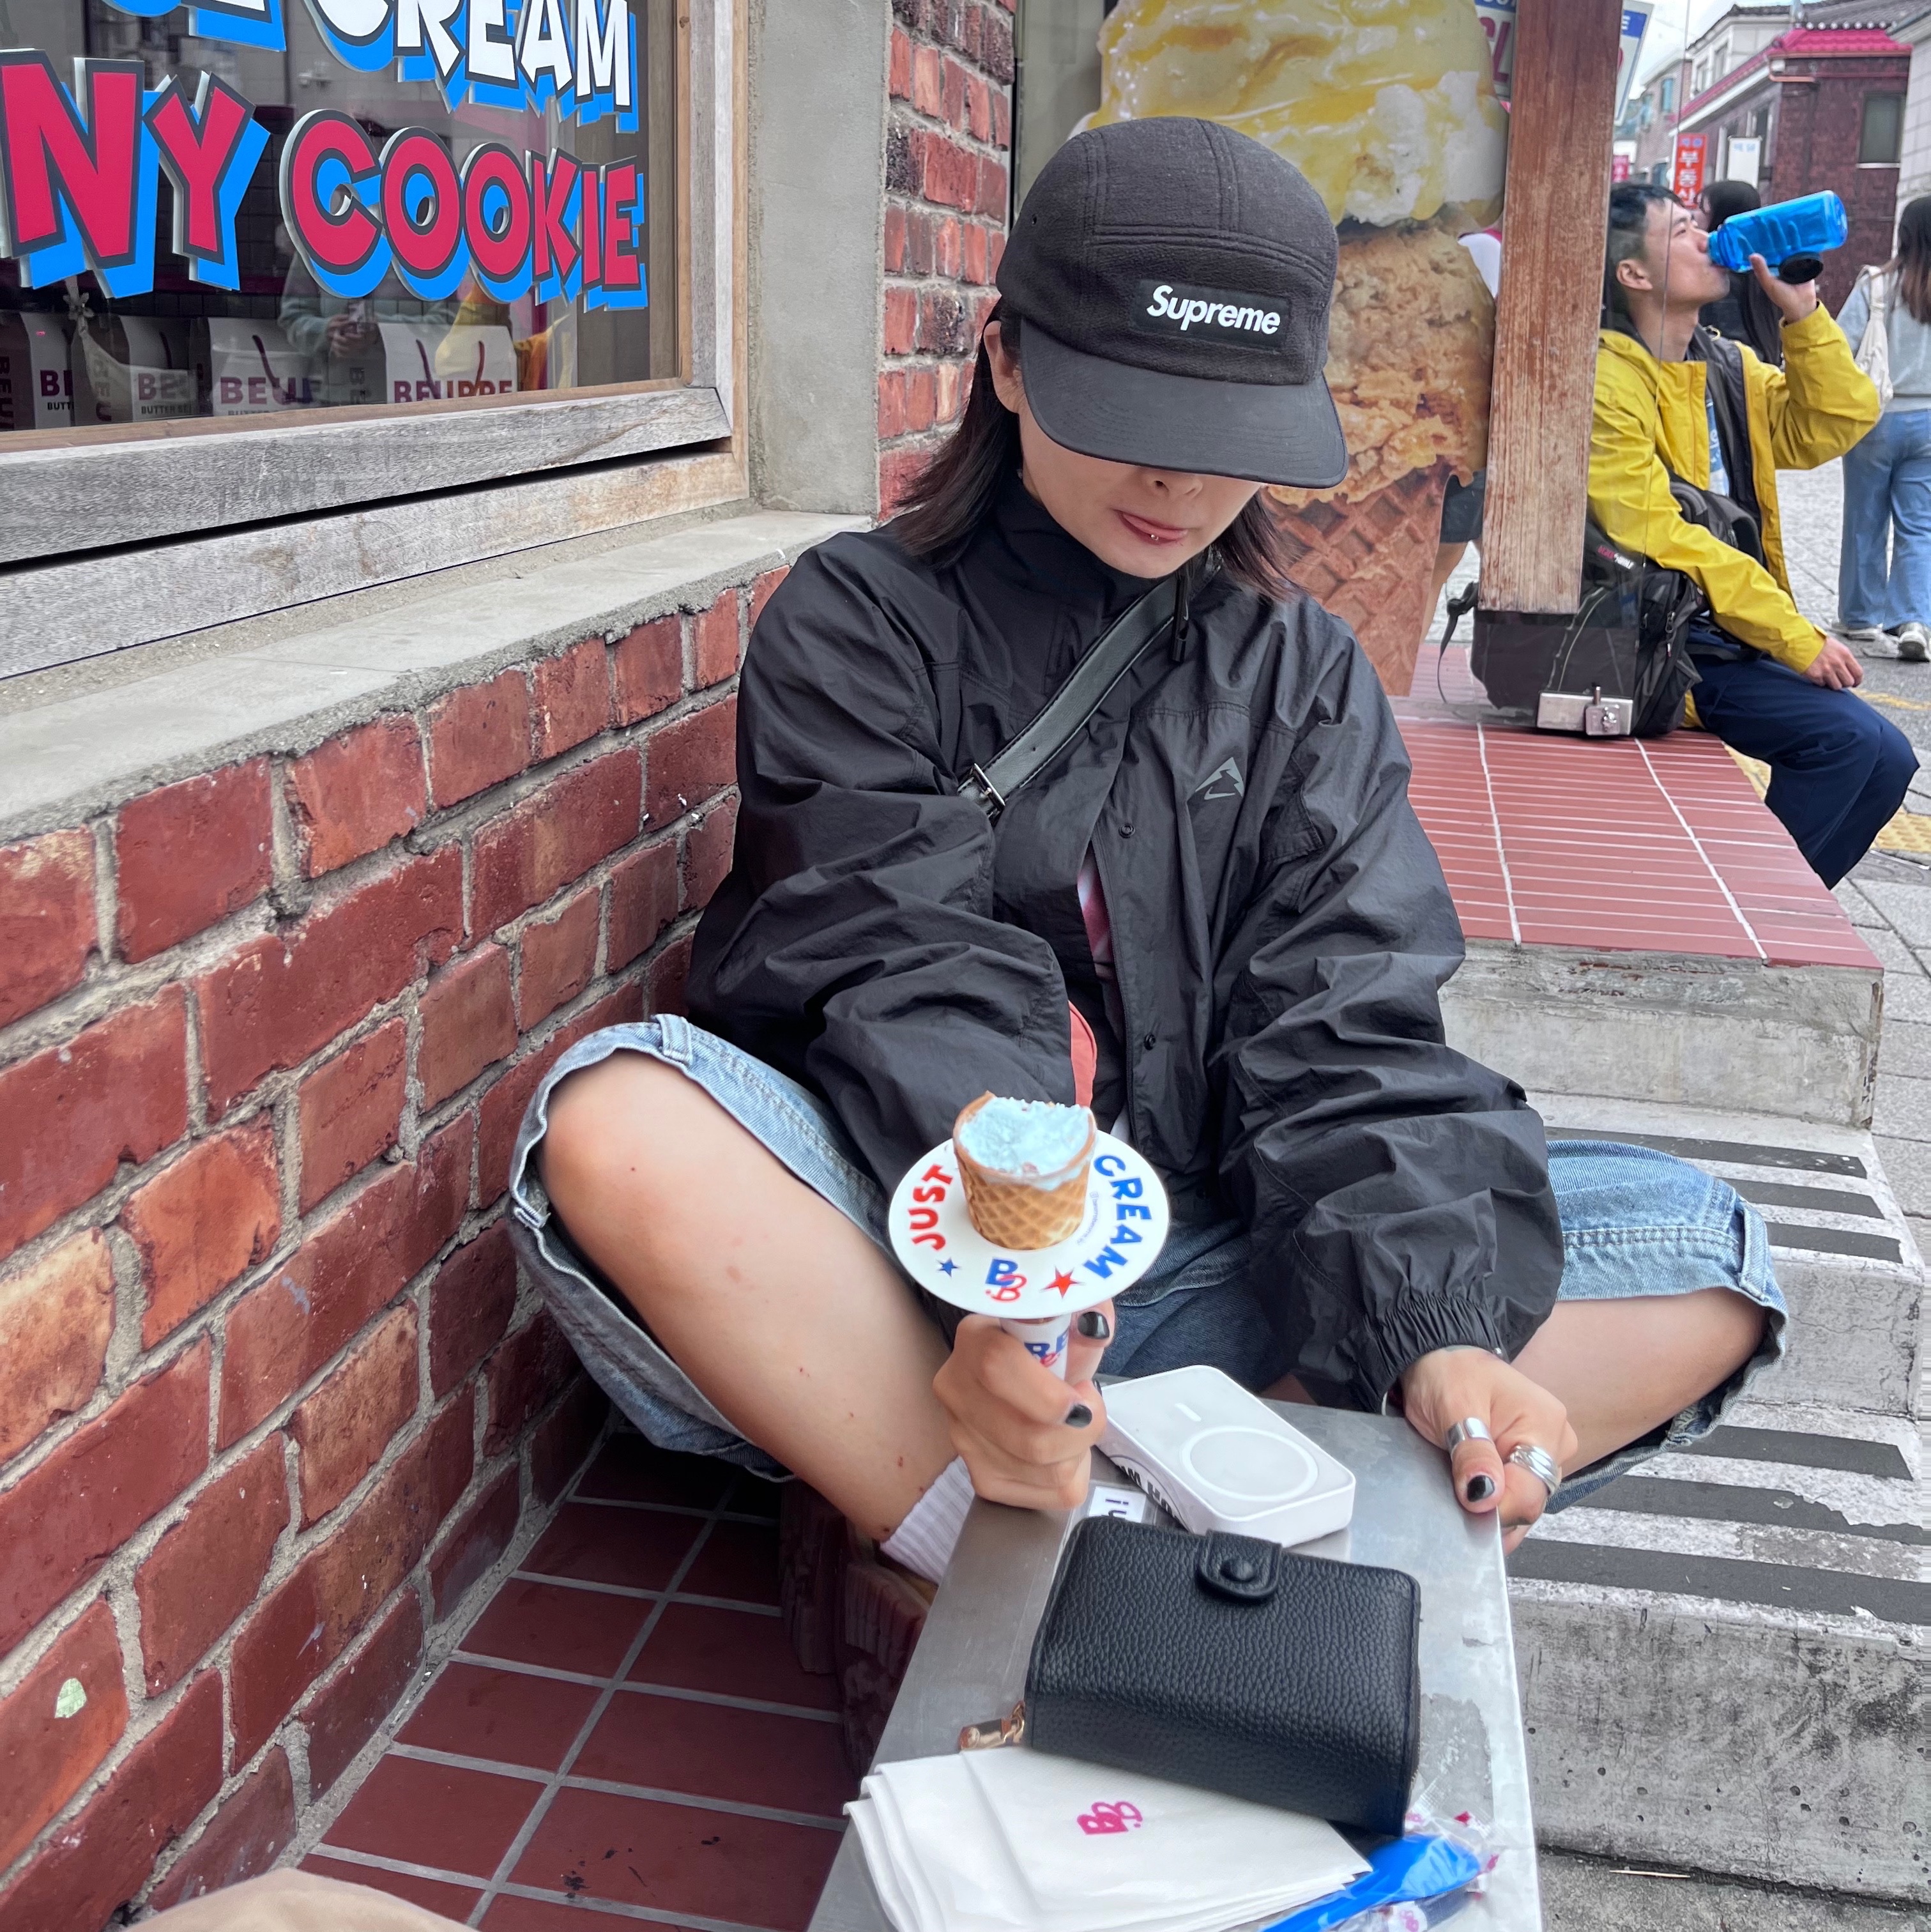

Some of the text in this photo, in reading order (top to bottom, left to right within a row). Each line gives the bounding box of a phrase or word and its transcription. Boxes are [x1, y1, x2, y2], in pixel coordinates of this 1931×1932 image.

[304, 0, 634, 114] REAM
[286, 109, 643, 294] COOKIE
[1679, 150, 1699, 206] 부동산
[1147, 285, 1280, 334] Supreme
[908, 1164, 954, 1251] JUST
[1082, 1154, 1152, 1279] CREAM
